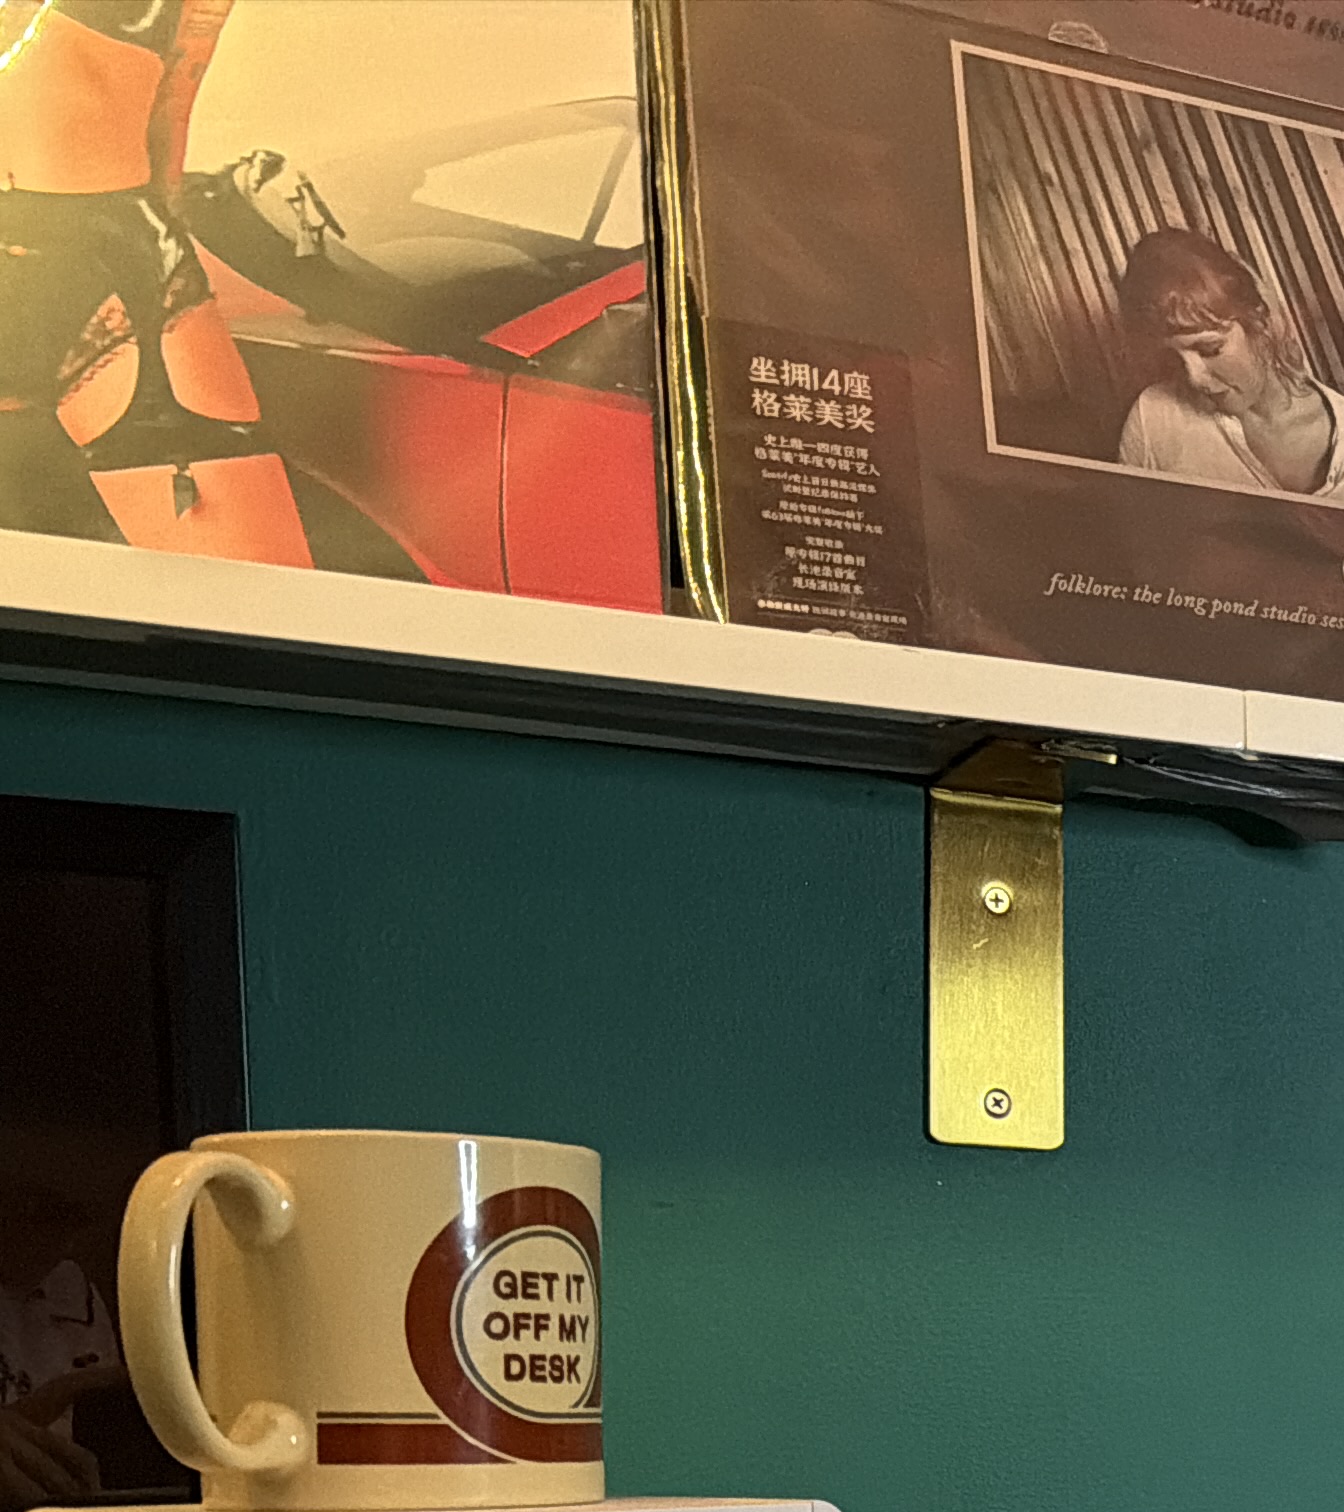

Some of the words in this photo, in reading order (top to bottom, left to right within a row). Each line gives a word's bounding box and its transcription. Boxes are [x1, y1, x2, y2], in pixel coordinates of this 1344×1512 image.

[748, 356, 874, 401] 坐拥14座
[751, 388, 876, 433] 格莱美奖
[1044, 572, 1128, 601] folklore:
[1133, 585, 1163, 605] the
[1167, 587, 1208, 616] long
[1208, 598, 1258, 619] pond
[1260, 604, 1317, 626] studio
[492, 1269, 560, 1302] GET
[566, 1273, 585, 1305] IT
[482, 1311, 551, 1342] OFF
[558, 1313, 590, 1343] MY
[503, 1352, 581, 1385] DESK
